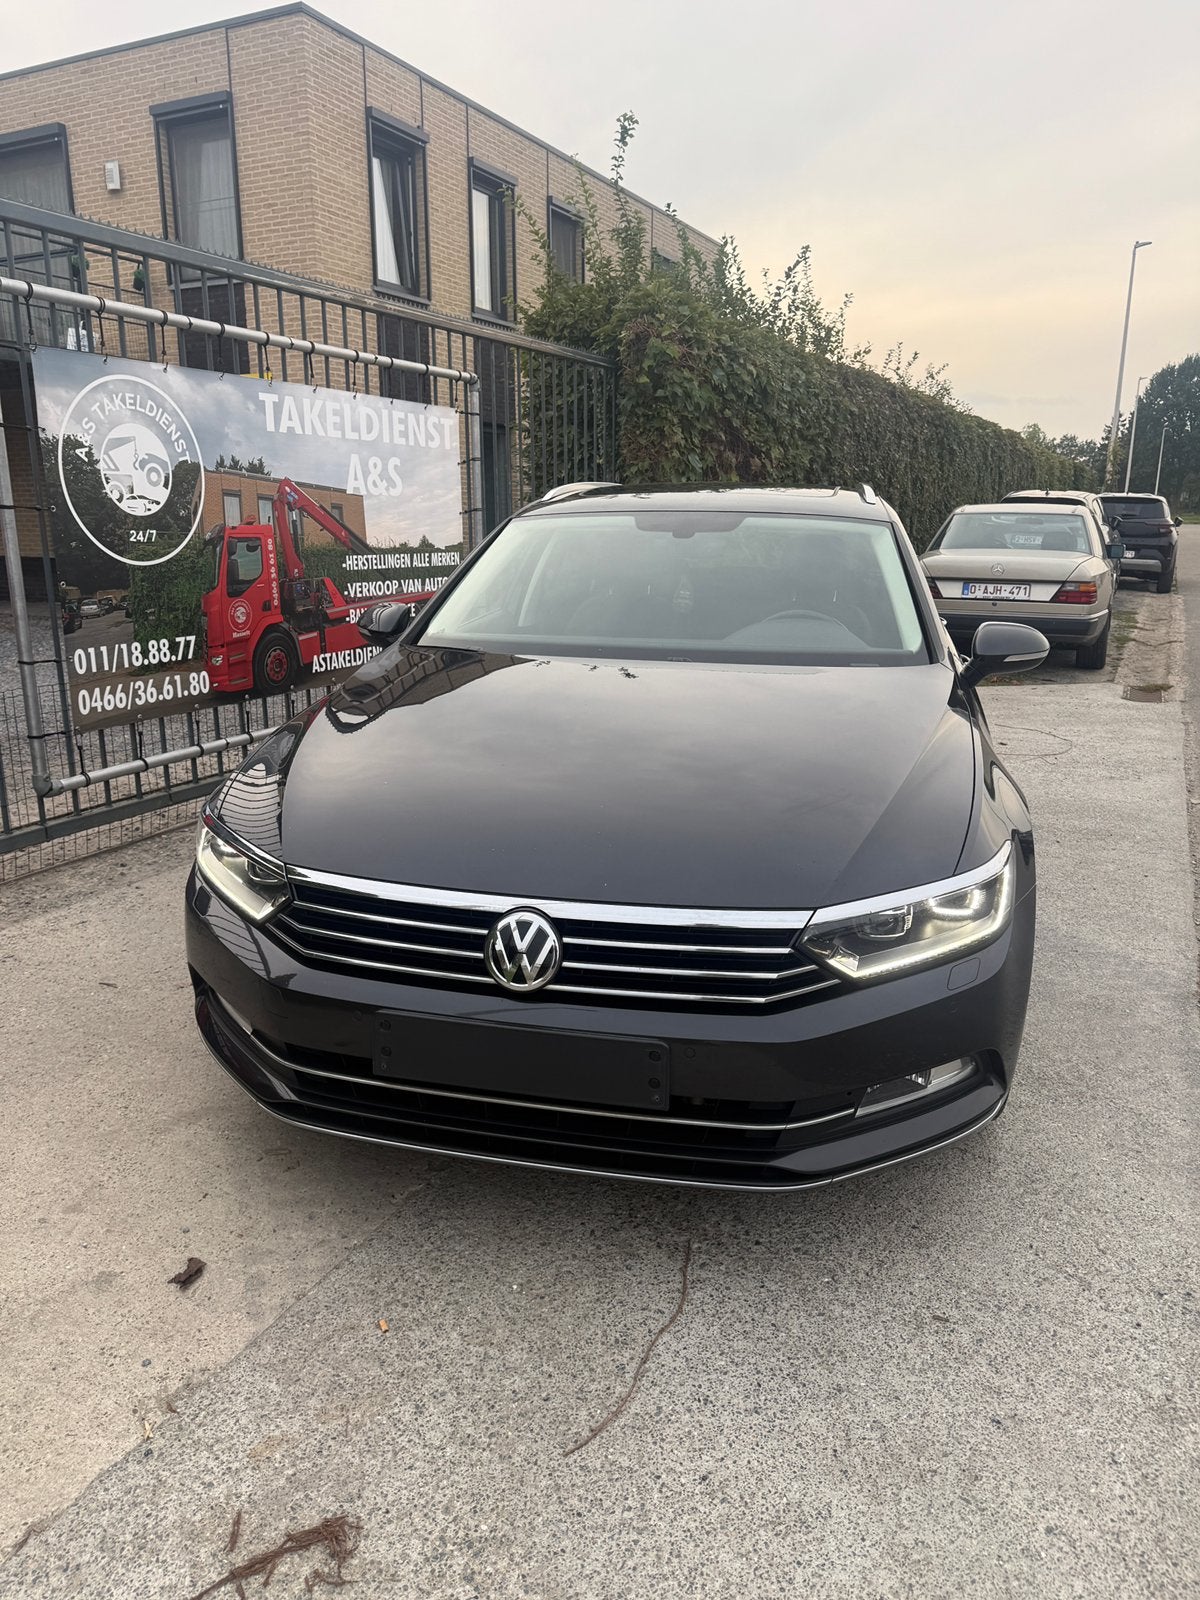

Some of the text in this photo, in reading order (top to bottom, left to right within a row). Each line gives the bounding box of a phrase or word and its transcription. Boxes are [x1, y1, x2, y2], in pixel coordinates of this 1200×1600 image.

[75, 392, 192, 464] A&S TAKELDIENST
[258, 391, 454, 450] TAKELDIENST
[346, 453, 403, 497] A&S
[129, 529, 157, 543] 24/7
[342, 551, 460, 571] -HERSTELLINGEN ALLE MERKEN
[344, 580, 399, 598] -VERKOOP
[401, 578, 422, 594] VAN
[73, 635, 196, 675] 011/18.88.77
[312, 645, 383, 674] ASTAKELDIEN
[78, 670, 210, 716] 0466/36.61.80
